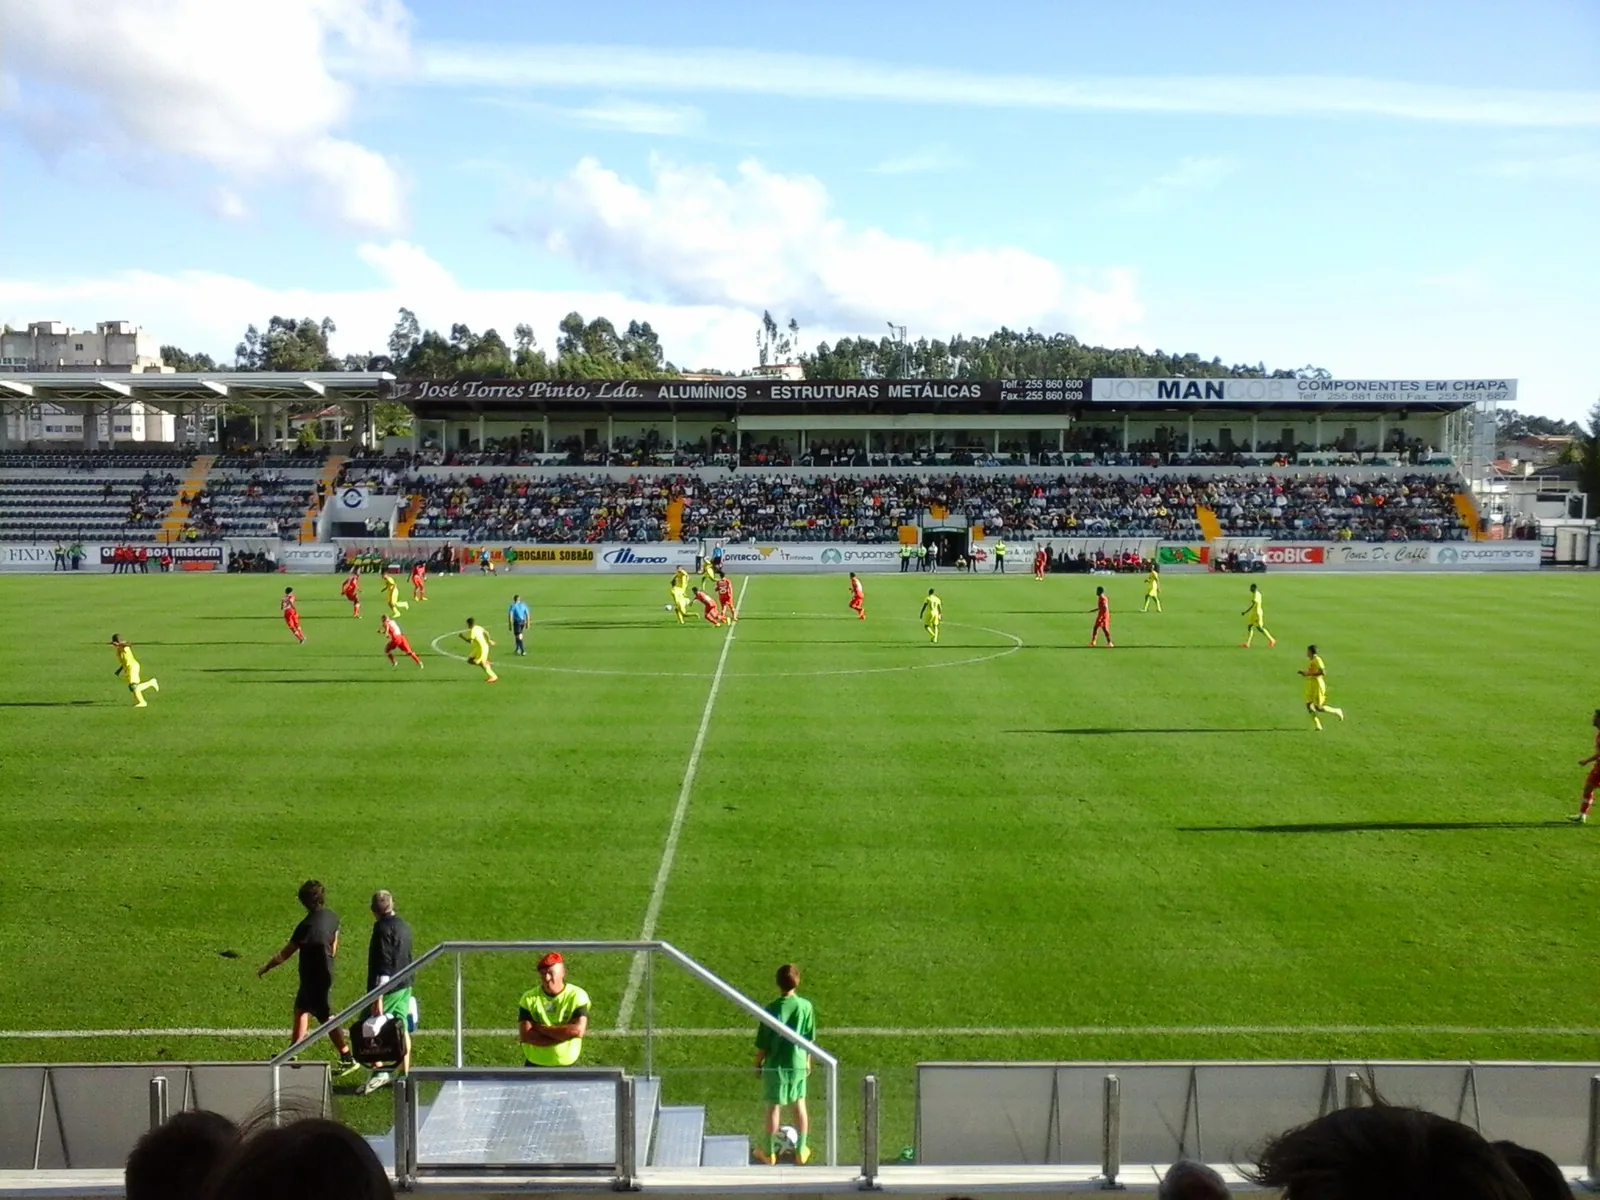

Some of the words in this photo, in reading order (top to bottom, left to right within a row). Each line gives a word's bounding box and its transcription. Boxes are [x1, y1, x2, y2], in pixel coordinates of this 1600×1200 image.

[415, 380, 459, 400] José
[462, 381, 525, 398] Torres
[529, 381, 591, 400] Pinto,
[595, 380, 644, 398] Lda.
[1025, 380, 1043, 389] 255
[1046, 380, 1063, 389] 860
[1065, 380, 1084, 389] 600
[1297, 380, 1420, 391] COMPONENTES
[1425, 381, 1447, 391] EM
[1452, 380, 1509, 391] CHAPA
[657, 383, 747, 399] ALUMÍNIOS
[770, 385, 880, 399] ESTRUTURAS
[888, 382, 981, 398] METÁLICAS
[1025, 391, 1043, 400] 255
[1046, 391, 1063, 400] 860
[1065, 391, 1083, 400] 609
[1327, 392, 1348, 400] 255
[560, 549, 594, 561] SOBRÃO
